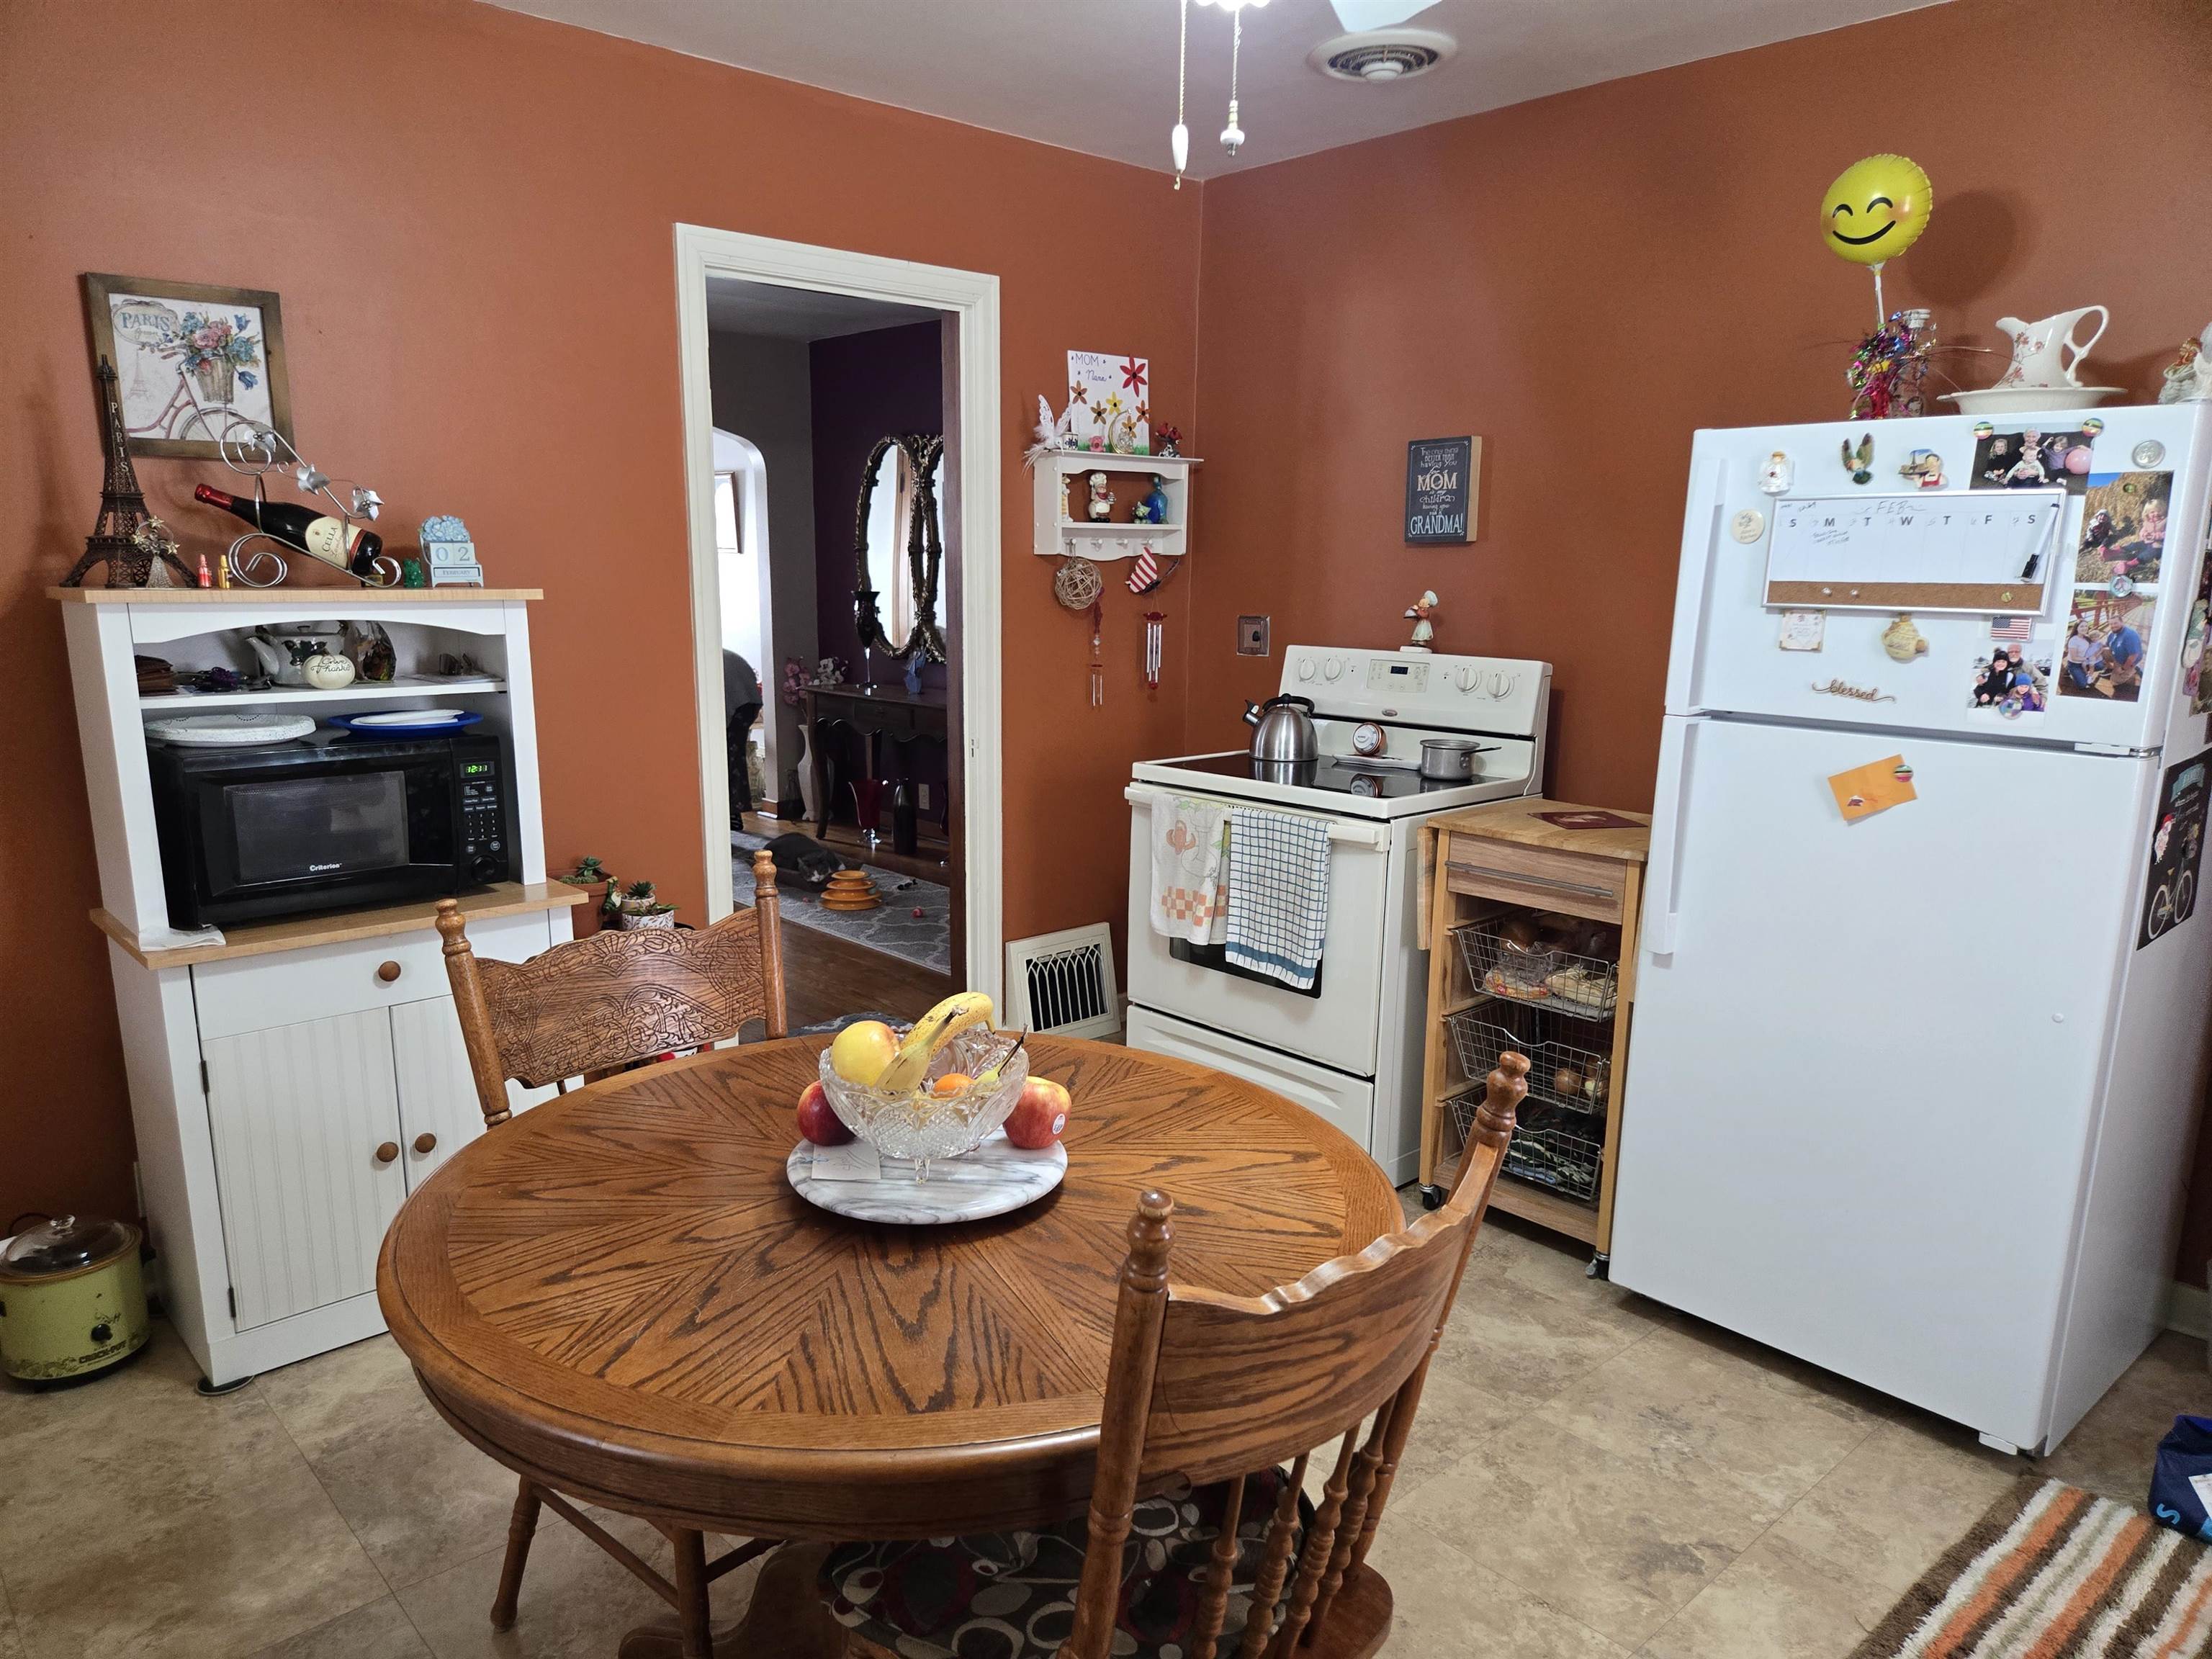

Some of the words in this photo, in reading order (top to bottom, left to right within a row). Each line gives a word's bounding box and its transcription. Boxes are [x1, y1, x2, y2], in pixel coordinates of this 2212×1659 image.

[120, 312, 170, 332] PARIS
[1075, 353, 1100, 367] MOM
[1086, 369, 1107, 382] Nana
[110, 402, 130, 473] PARIS
[1417, 472, 1458, 491] MOM
[1411, 513, 1464, 535] GRANDMA!
[1789, 518, 1797, 528] S
[1824, 518, 1836, 527] M
[1863, 517, 1872, 526] T
[1900, 516, 1914, 526] W
[1943, 516, 1951, 525] T
[1984, 515, 1992, 524] F
[2028, 514, 2036, 524] S
[322, 527, 338, 552] CELLA
[465, 765, 487, 773] 12:11
[310, 863, 341, 872] Criterion
